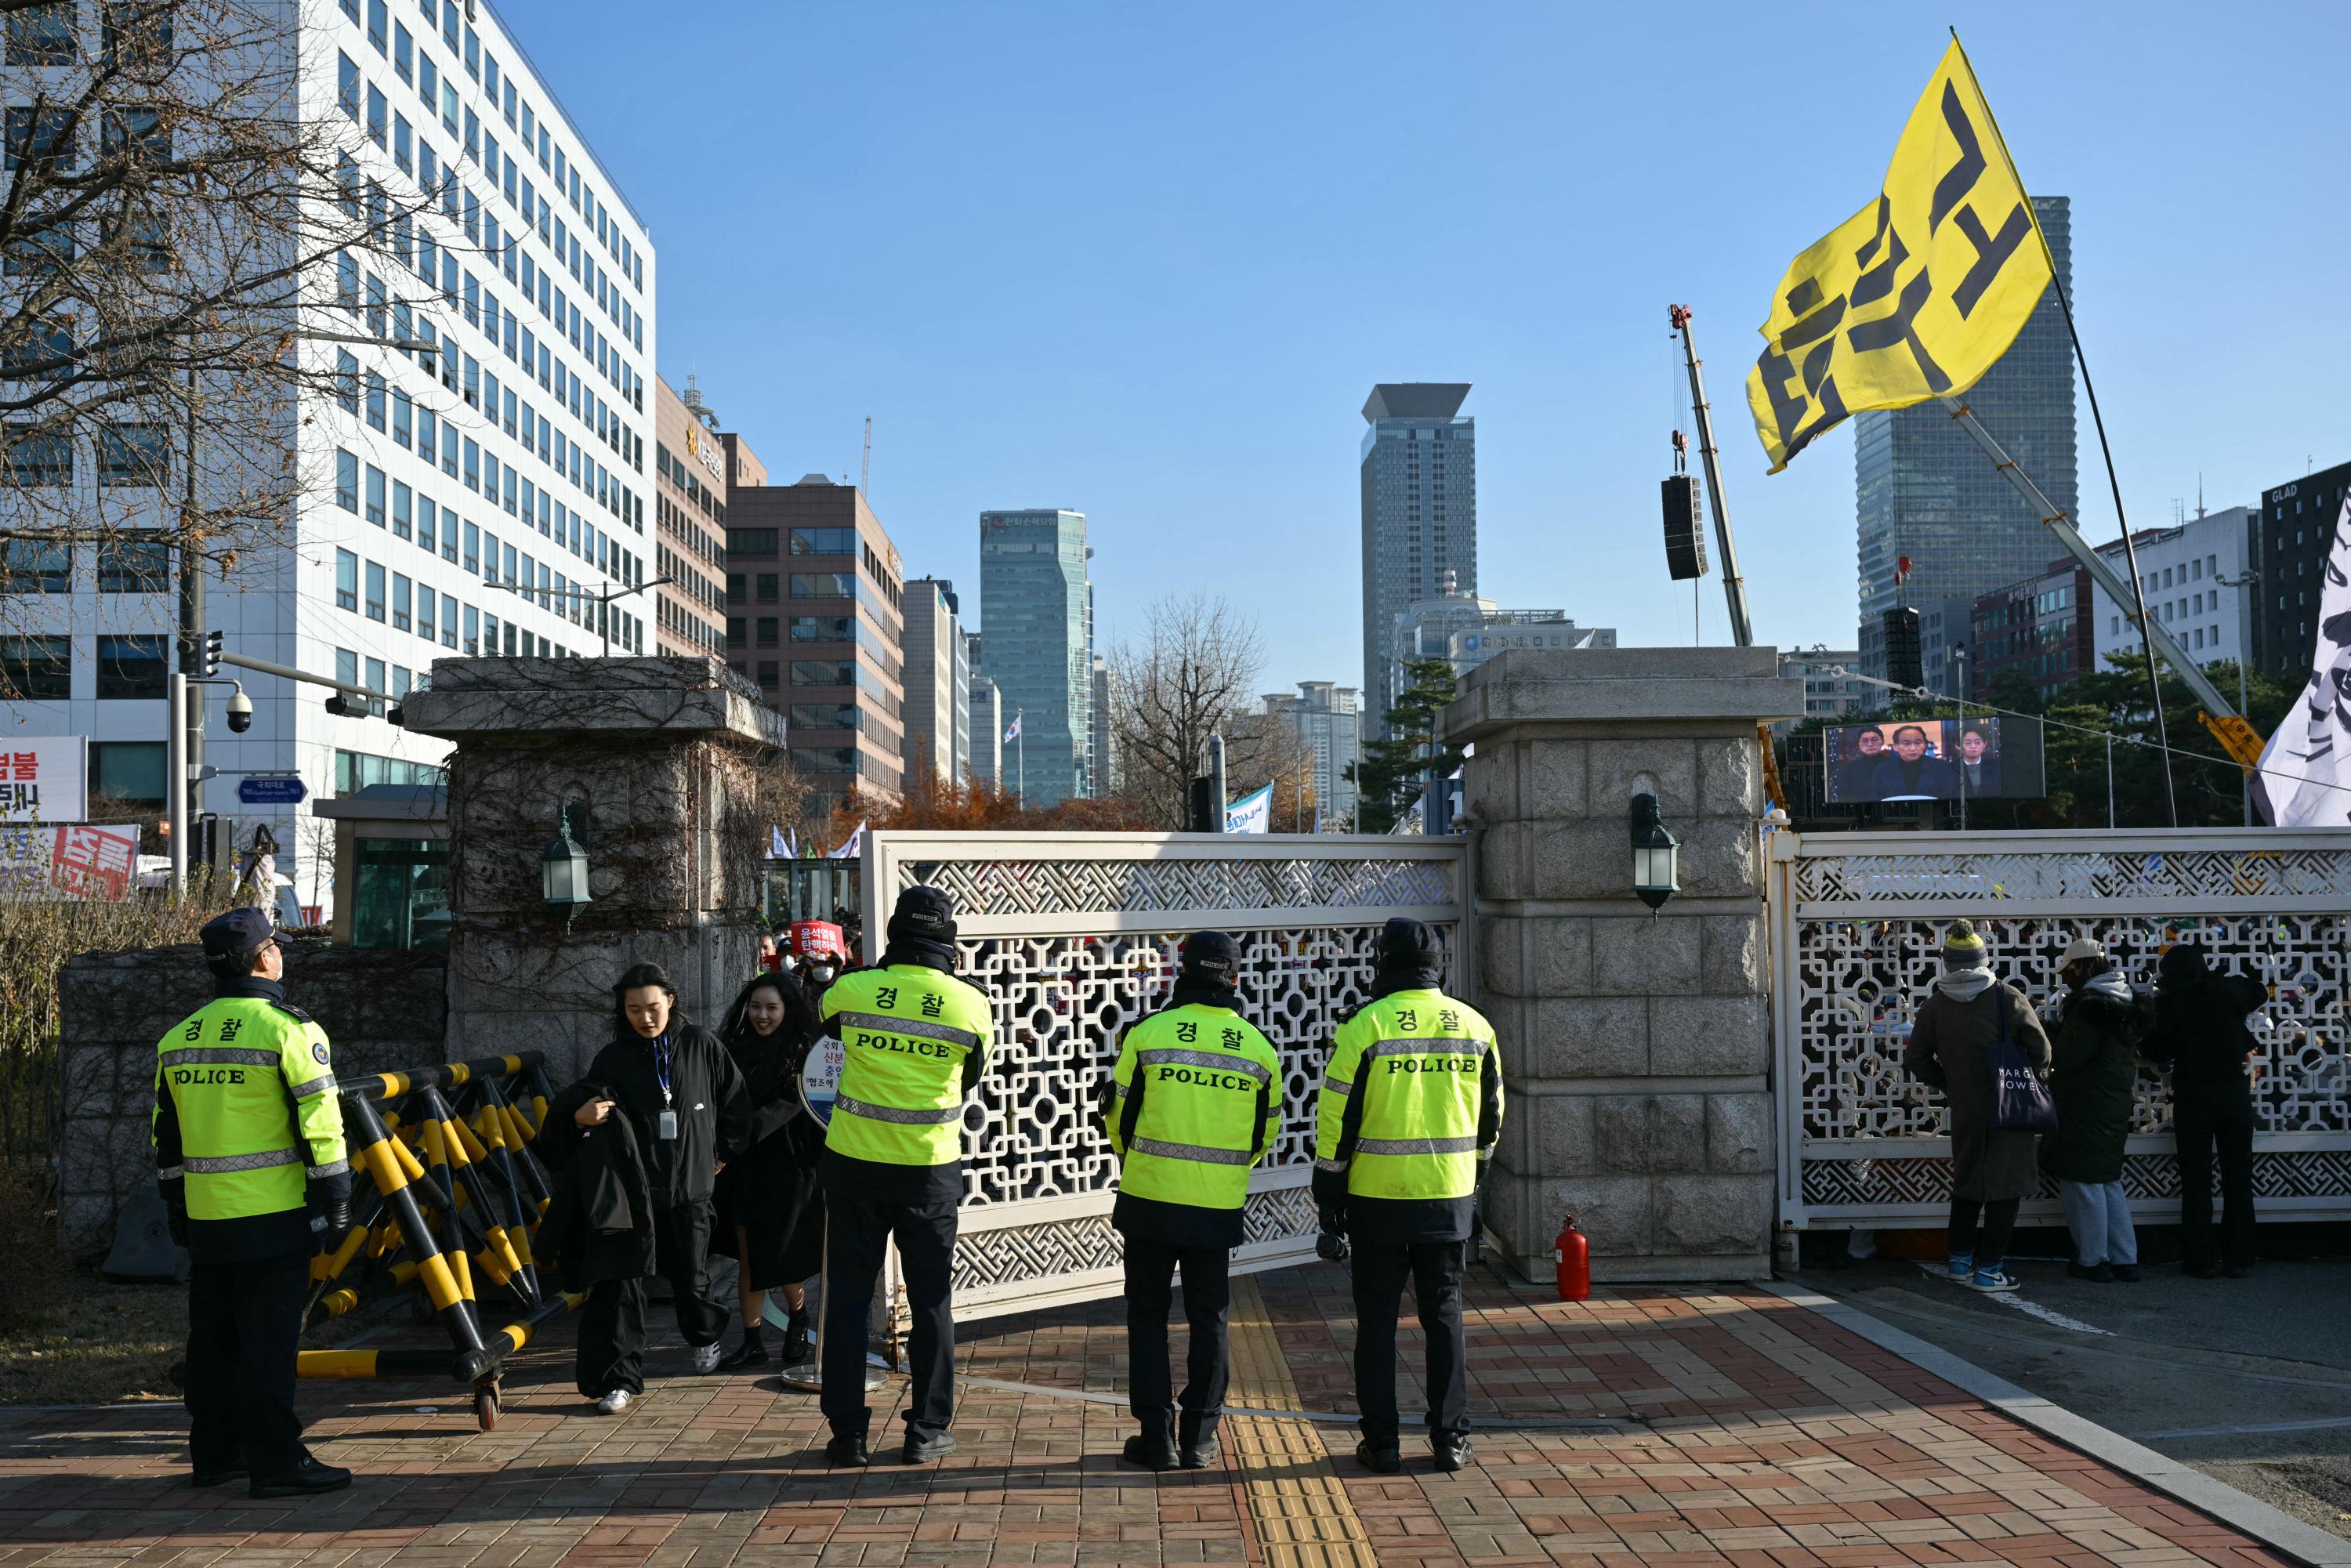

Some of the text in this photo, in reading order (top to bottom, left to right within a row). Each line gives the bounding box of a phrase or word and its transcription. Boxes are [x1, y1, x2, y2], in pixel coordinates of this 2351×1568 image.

[2273, 484, 2298, 503] GLAD
[800, 928, 836, 942] 윤석열을
[802, 940, 838, 952] 탄핵하라
[1204, 961, 1227, 970] POLICE
[875, 987, 945, 1018] 경찰
[185, 1018, 242, 1041] 경찰
[1396, 1009, 1460, 1032] 경찰
[855, 1033, 950, 1058] POLICE
[1176, 1022, 1244, 1051] 경찰
[822, 1041, 839, 1052] 국회
[1387, 1059, 1476, 1074] POLICE
[173, 1069, 245, 1085] POLICE
[1158, 1067, 1252, 1092] POLICE
